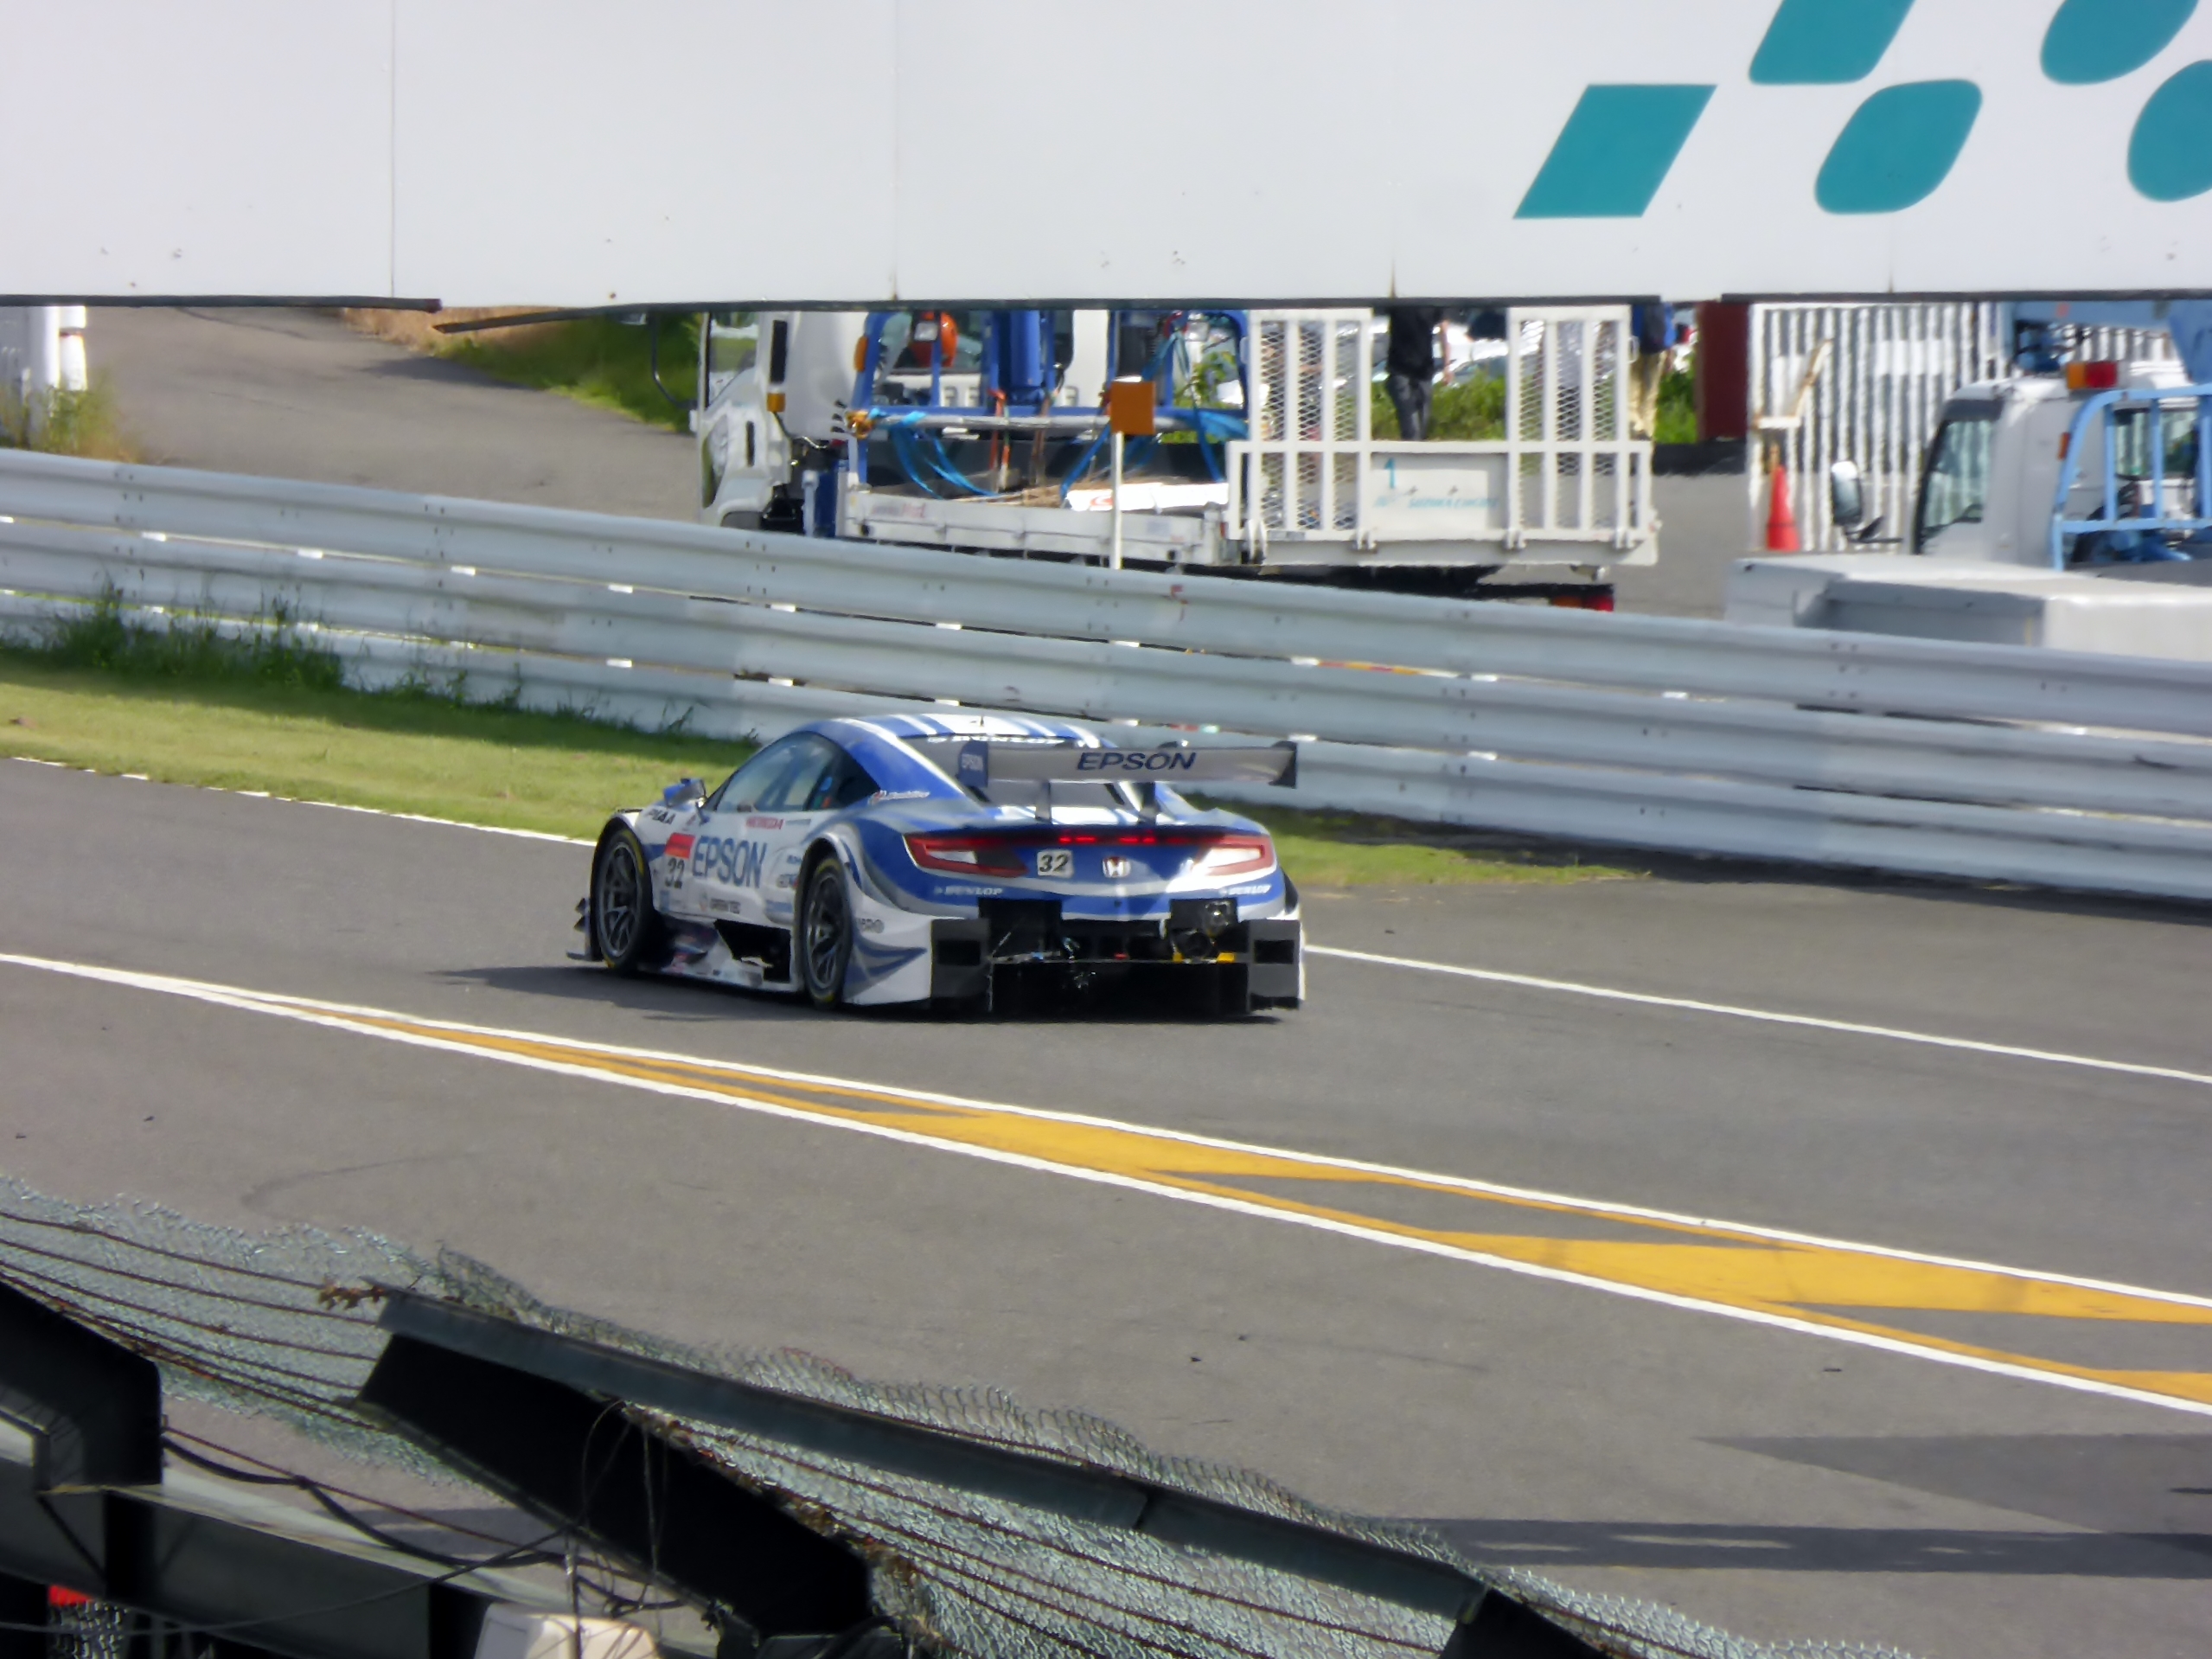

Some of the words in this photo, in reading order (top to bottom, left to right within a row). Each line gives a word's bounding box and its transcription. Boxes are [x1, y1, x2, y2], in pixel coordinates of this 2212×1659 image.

[1077, 752, 1197, 771] EPSON
[665, 857, 685, 890] 32
[692, 835, 768, 889] EPSON
[1039, 854, 1069, 873] 32
